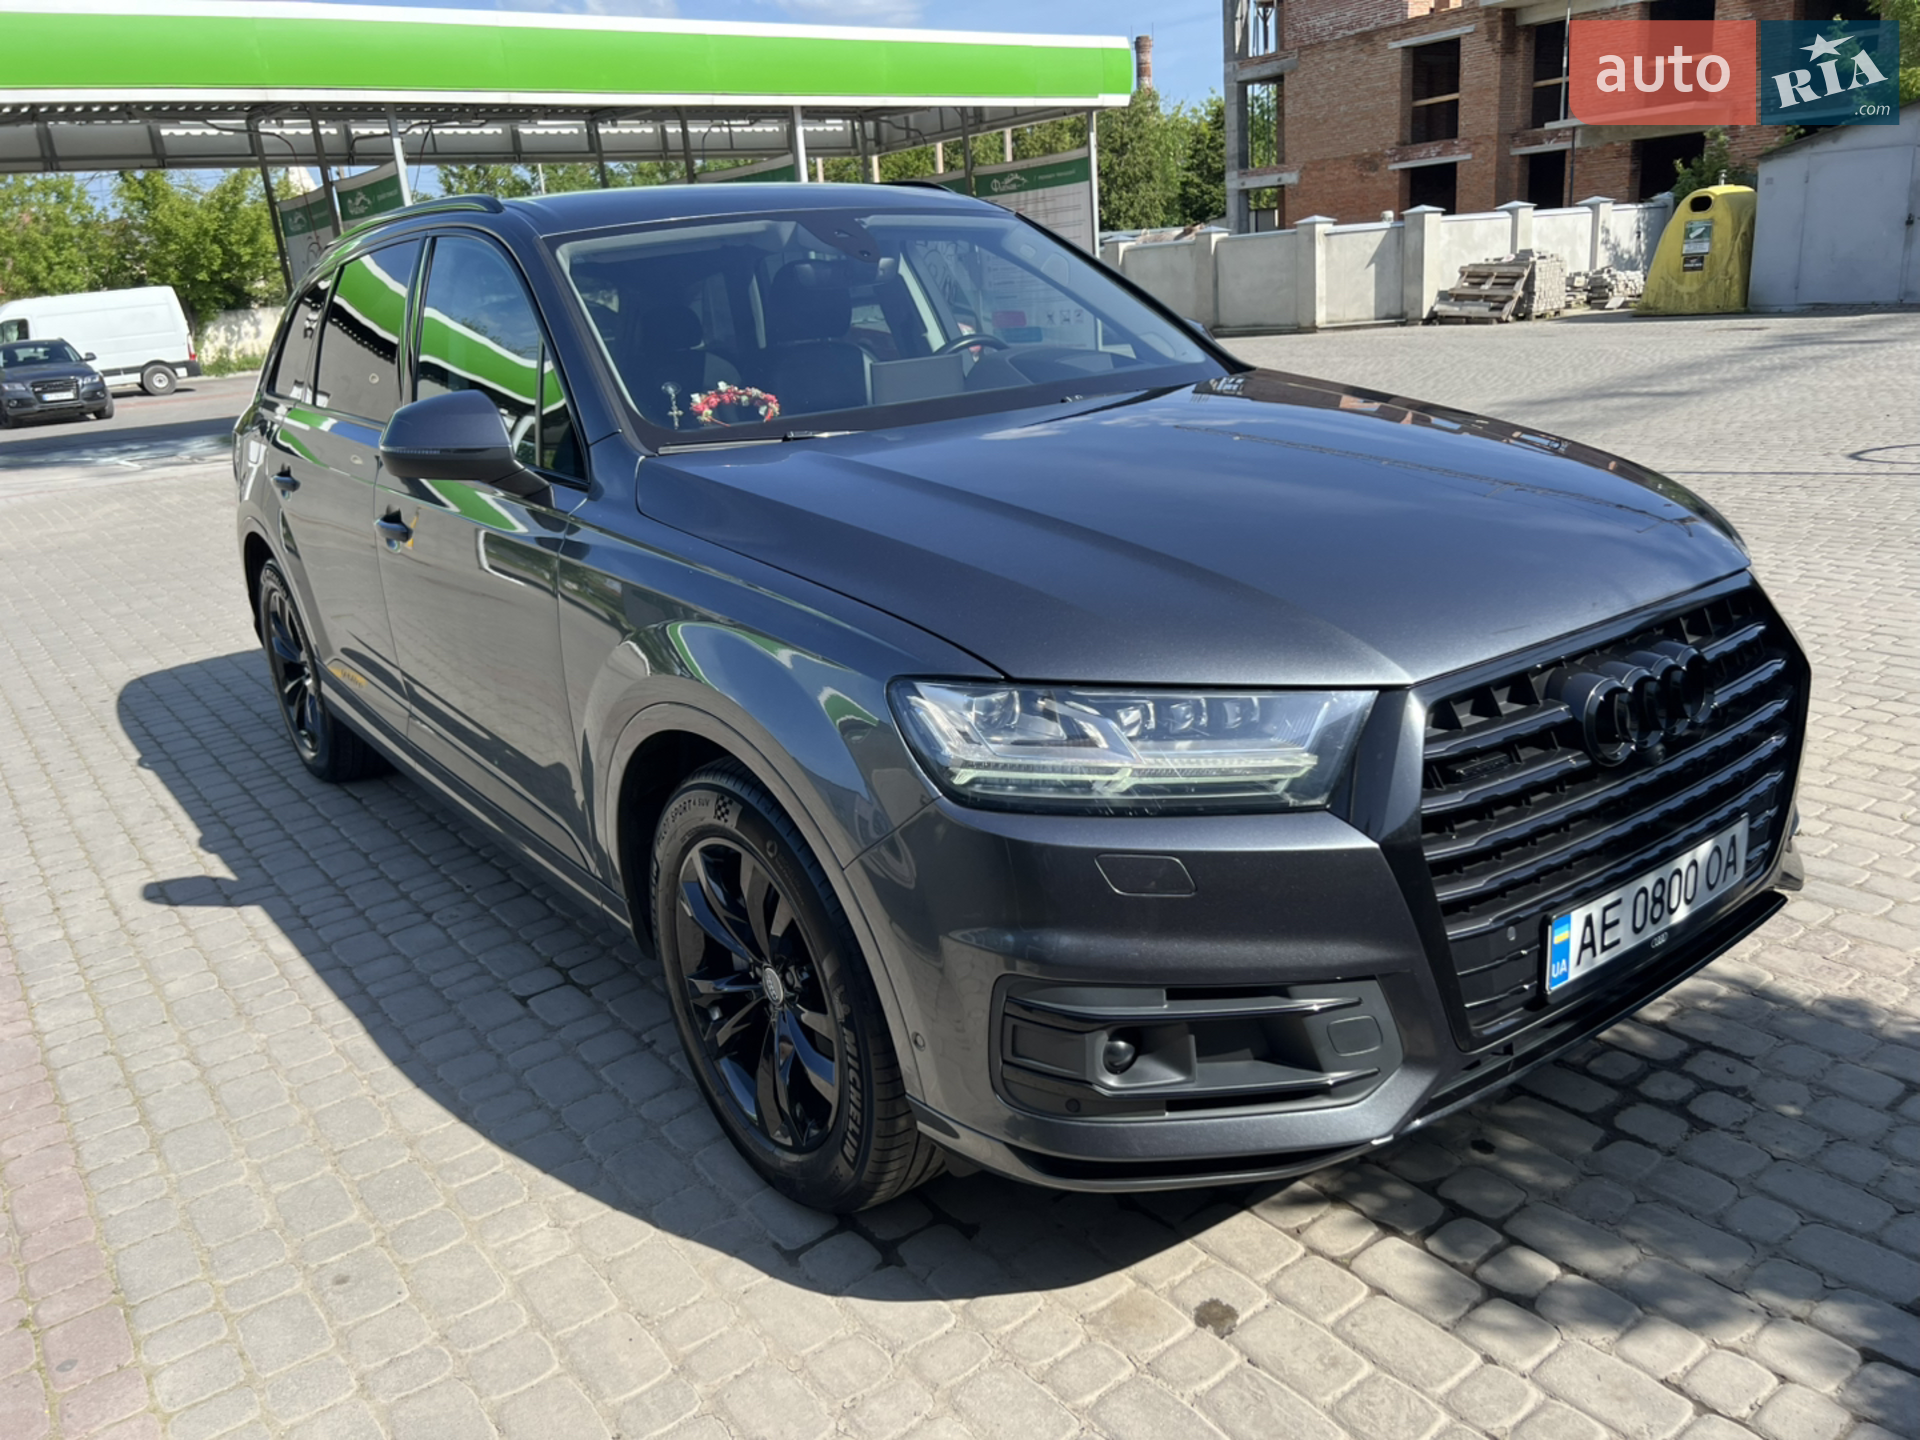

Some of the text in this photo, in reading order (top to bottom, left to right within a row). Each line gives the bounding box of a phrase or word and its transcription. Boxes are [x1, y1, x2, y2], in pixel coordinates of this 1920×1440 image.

[671, 799, 692, 823] SPORT
[1576, 834, 1738, 967] AE 0800 OA
[1551, 959, 1568, 979] UA
[842, 1025, 863, 1164] MICHELIN
